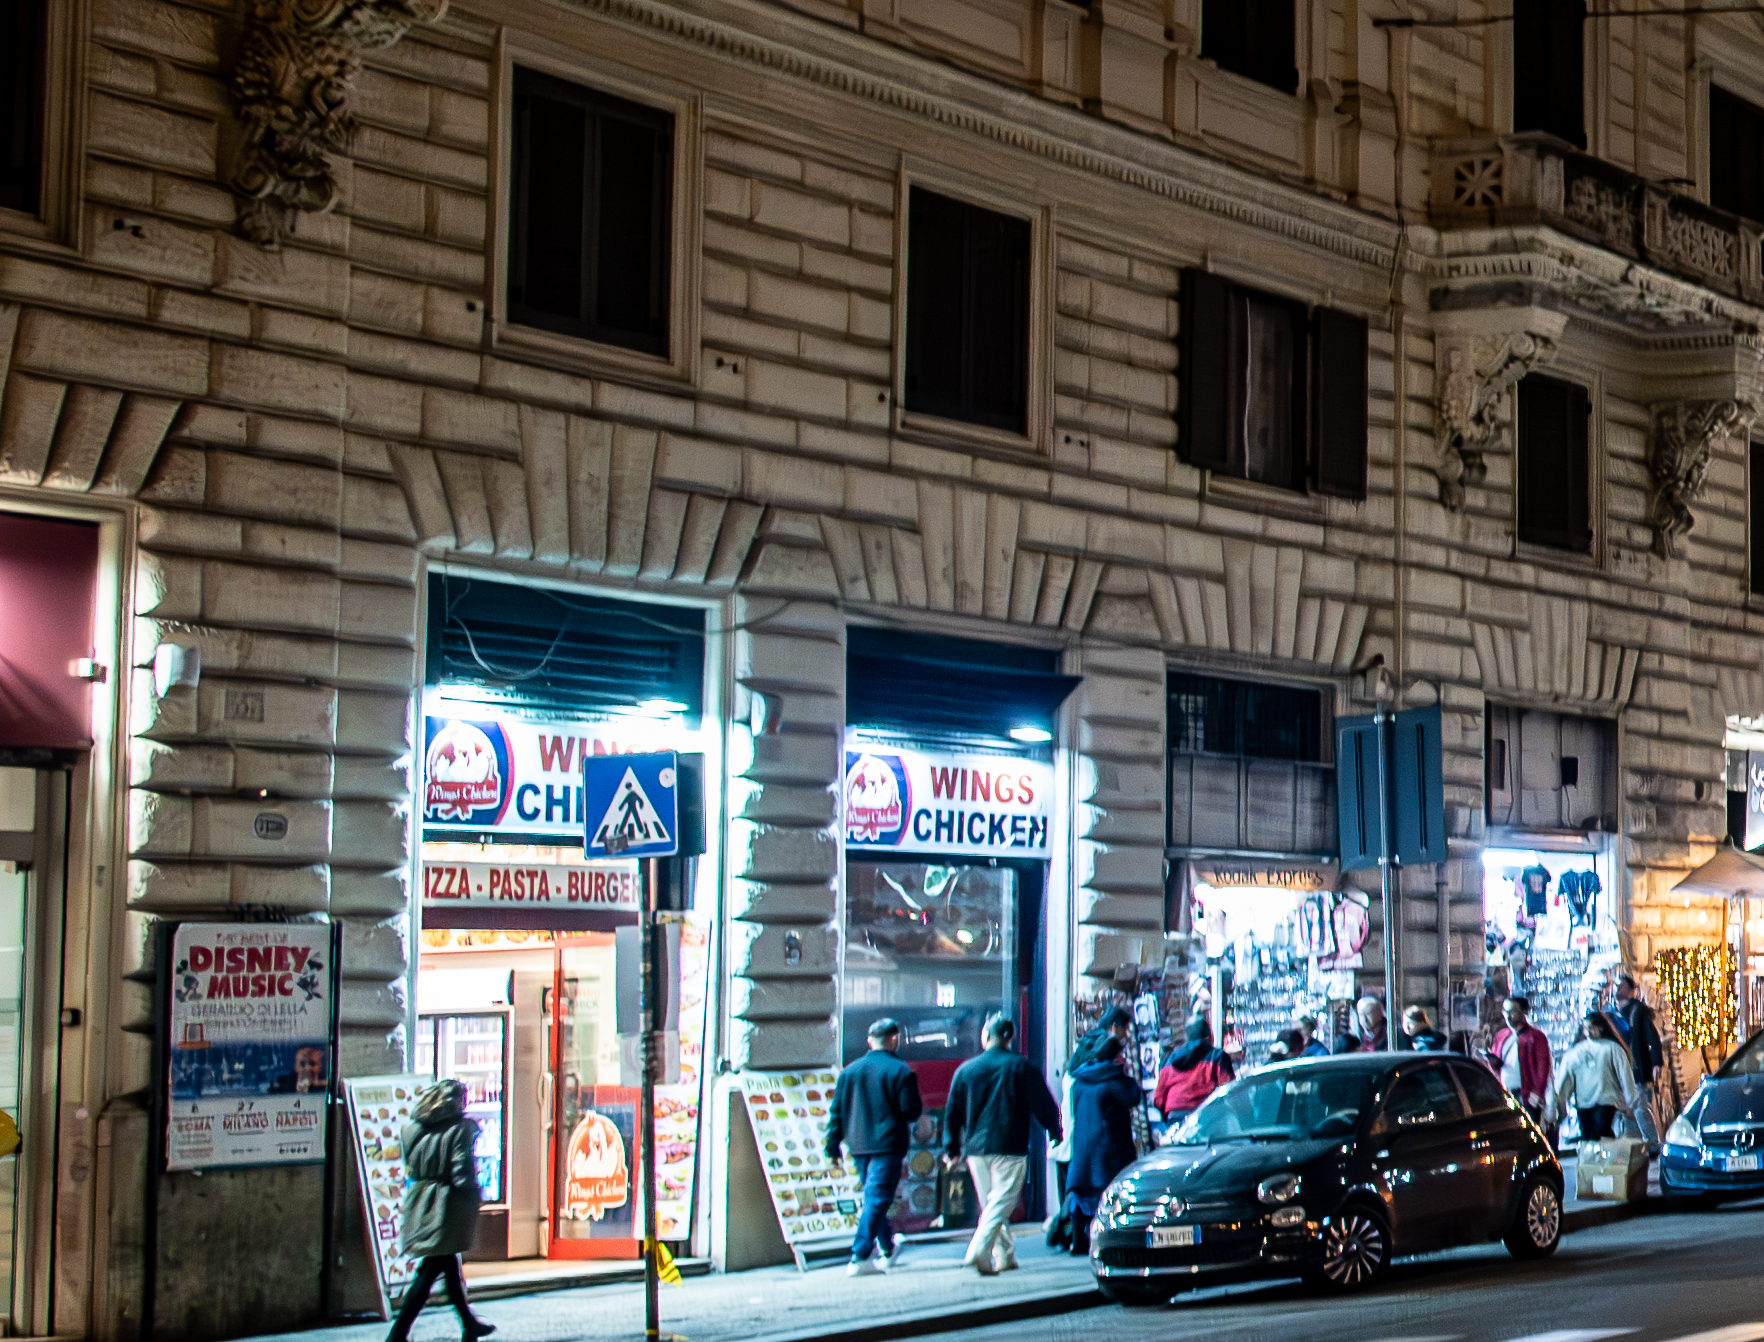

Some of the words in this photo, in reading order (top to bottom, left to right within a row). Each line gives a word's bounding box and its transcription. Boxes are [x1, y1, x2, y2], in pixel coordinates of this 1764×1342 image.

[930, 765, 1035, 805] WINGS
[913, 808, 1048, 848] CHICKEN
[424, 866, 471, 900] IZZA
[489, 868, 551, 902] PASTA
[189, 945, 312, 974] DISNEY
[206, 972, 294, 1000] MUSIC
